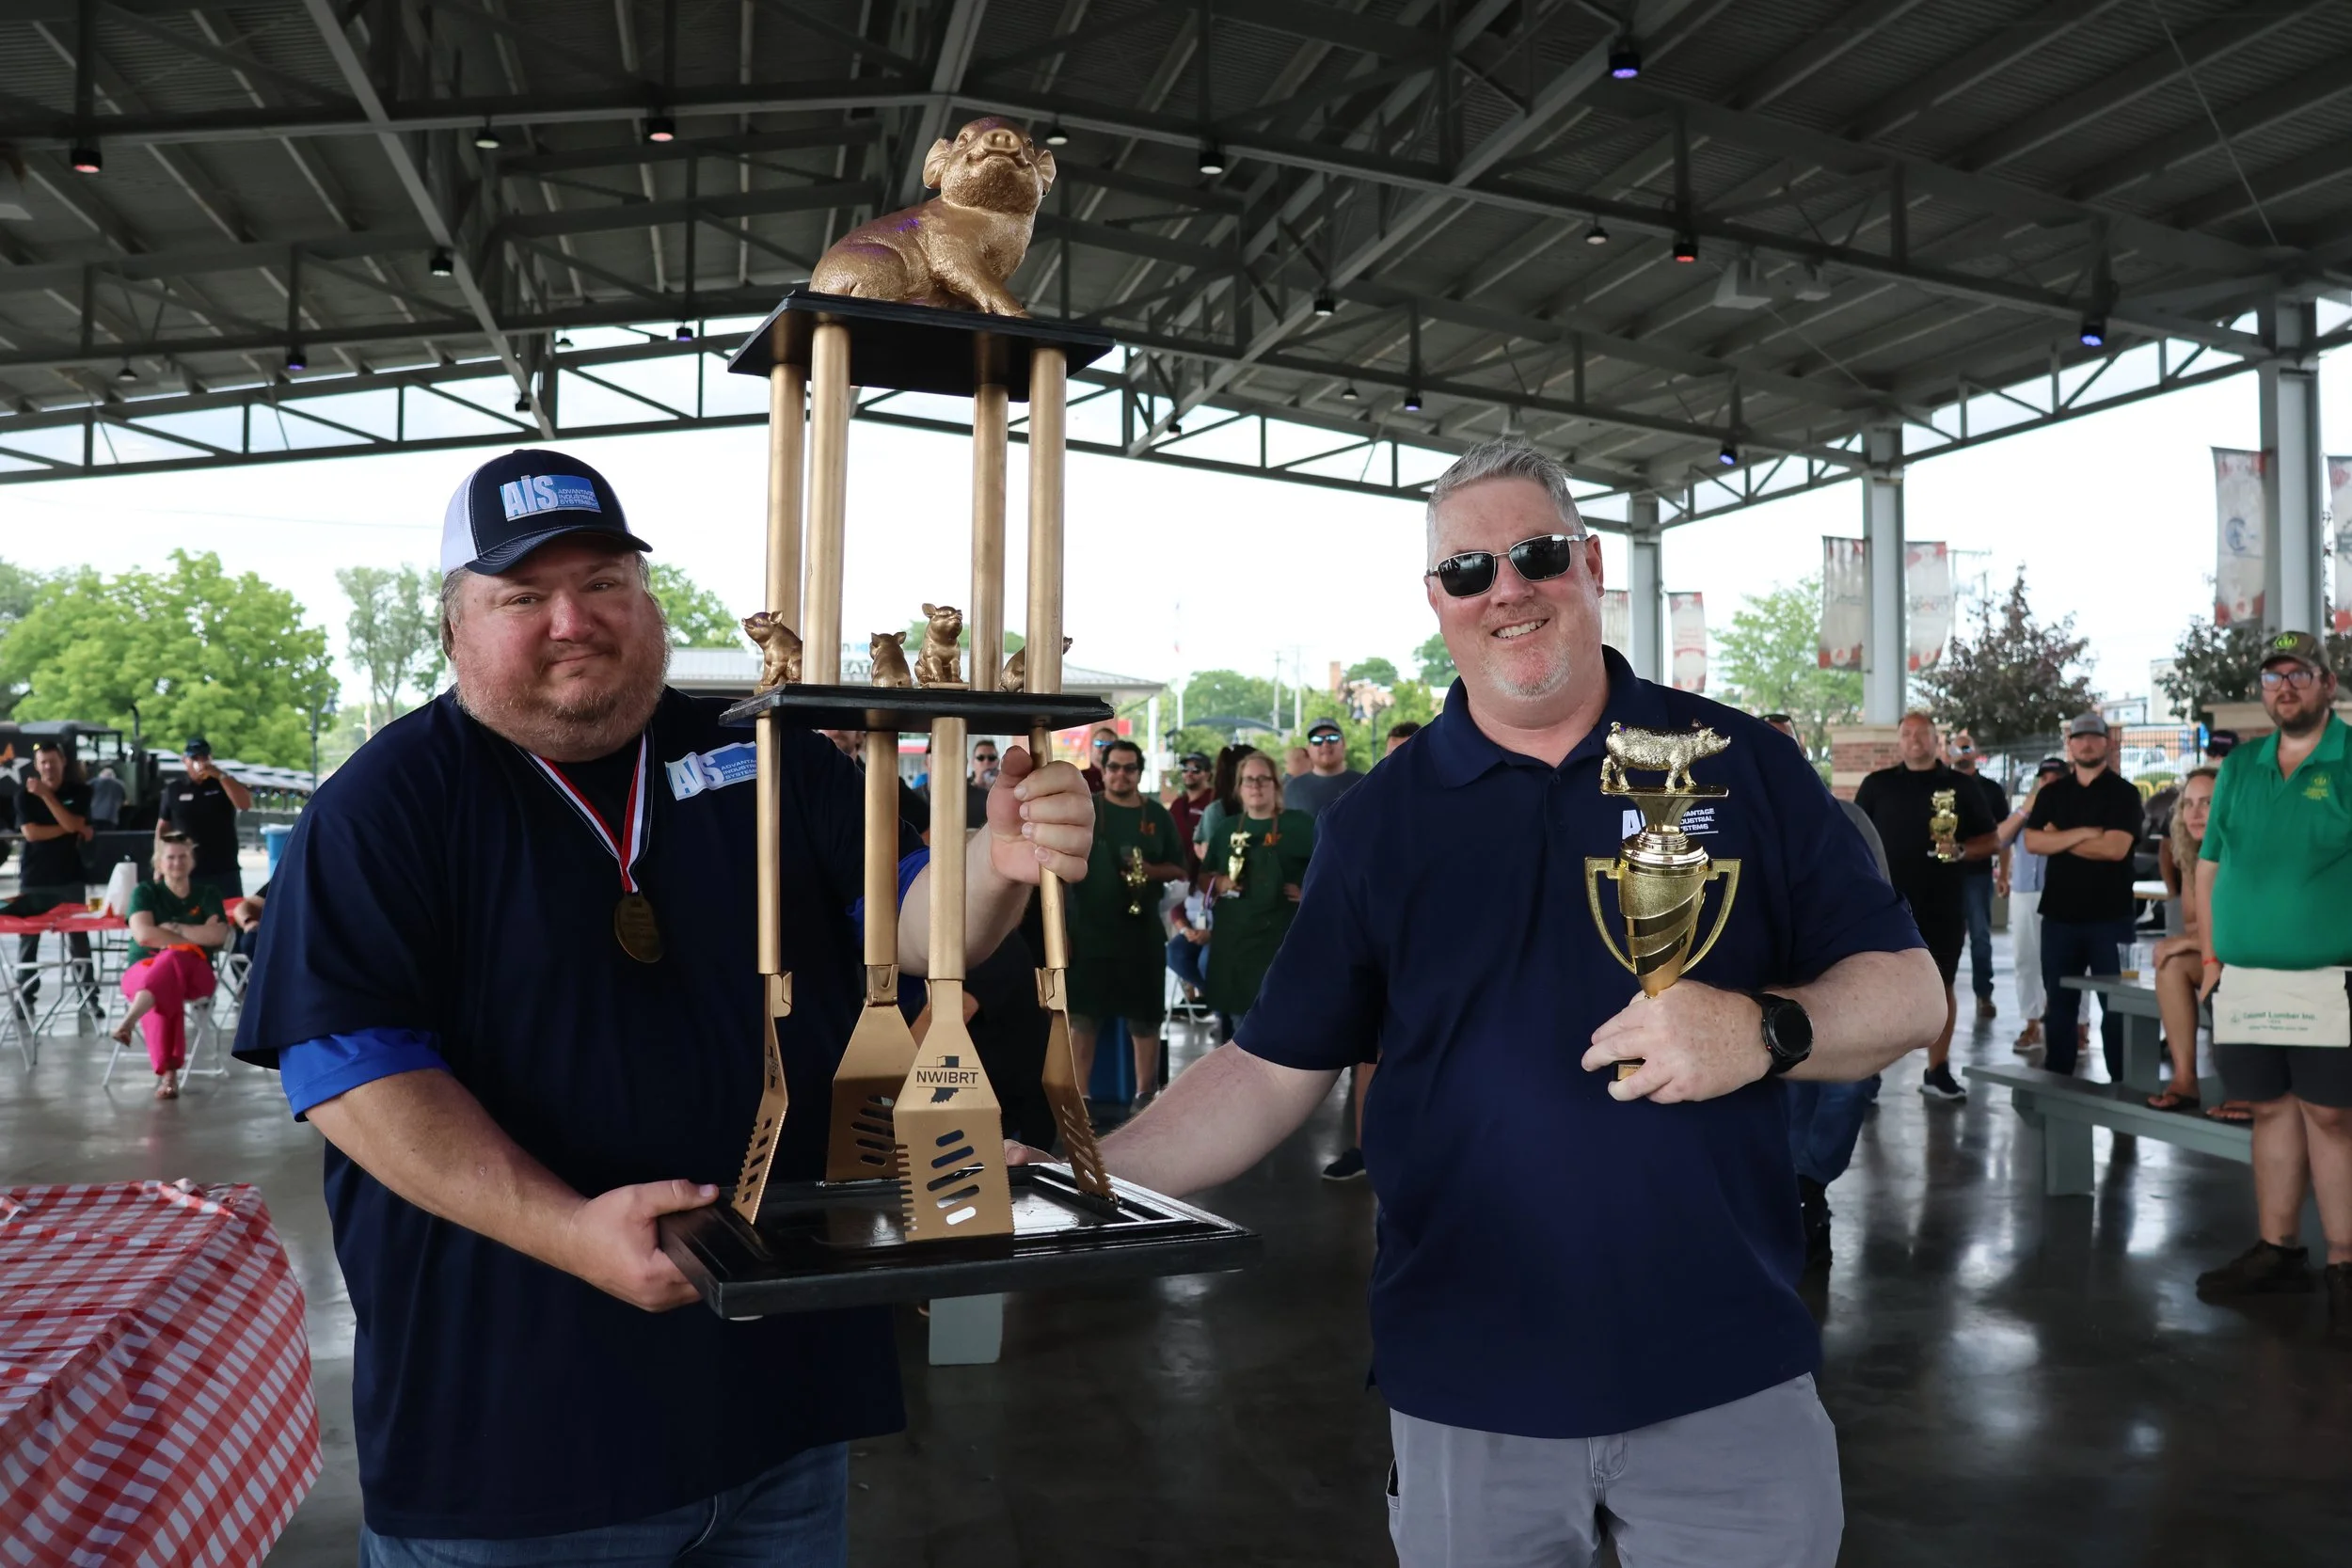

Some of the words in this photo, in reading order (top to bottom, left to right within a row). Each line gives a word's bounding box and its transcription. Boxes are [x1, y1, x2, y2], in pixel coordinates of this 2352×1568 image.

[503, 475, 558, 518] AIS
[1683, 808, 1715, 817] ANTAGE
[1679, 816, 1715, 825] DUSTRIAL
[1681, 823, 1709, 832] STEMS
[916, 1070, 978, 1085] NWIBRT
